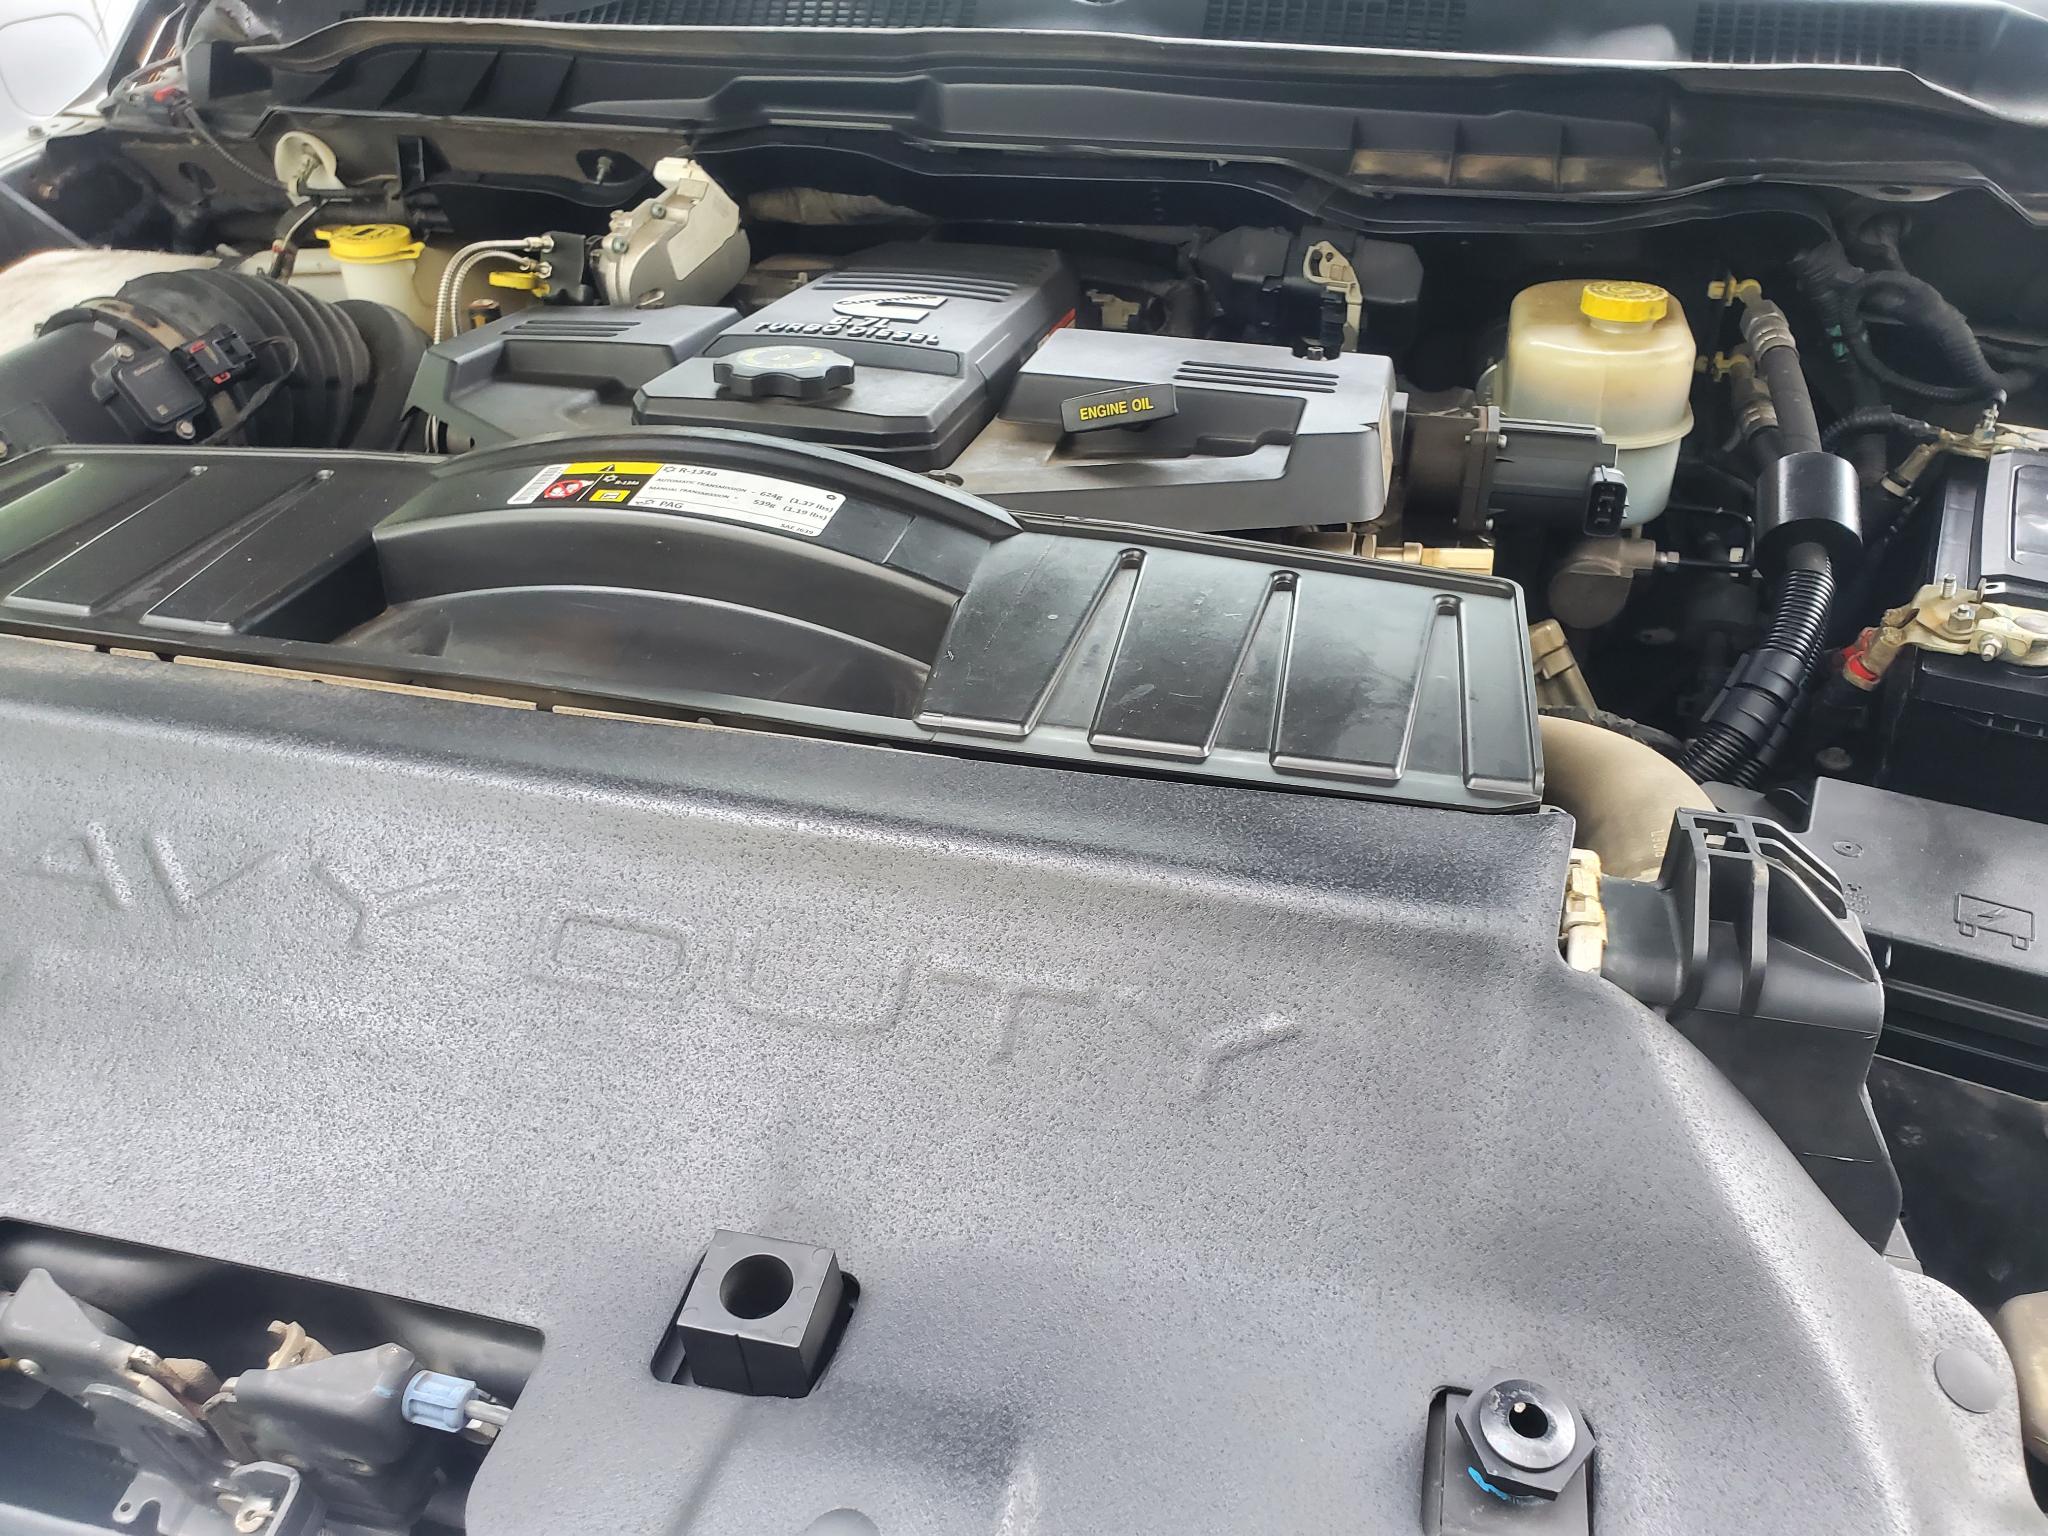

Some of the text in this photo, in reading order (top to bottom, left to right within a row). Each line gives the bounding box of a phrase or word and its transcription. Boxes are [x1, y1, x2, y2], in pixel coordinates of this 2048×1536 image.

[754, 321, 940, 346] TURBO DIESEL
[829, 315, 892, 329] 6.7L
[1080, 397, 1154, 420] ENGINE OIL
[678, 467, 718, 477] R-134a
[659, 500, 684, 509] PAG
[680, 488, 730, 499] TRANSMISSION
[753, 499, 776, 509] 539g
[783, 505, 808, 515] (1.19
[810, 510, 828, 521] lbs)
[697, 481, 747, 493] TRANSMISSION
[759, 491, 783, 501] 624g
[789, 497, 814, 508] (1.37
[815, 502, 834, 513] lbs)
